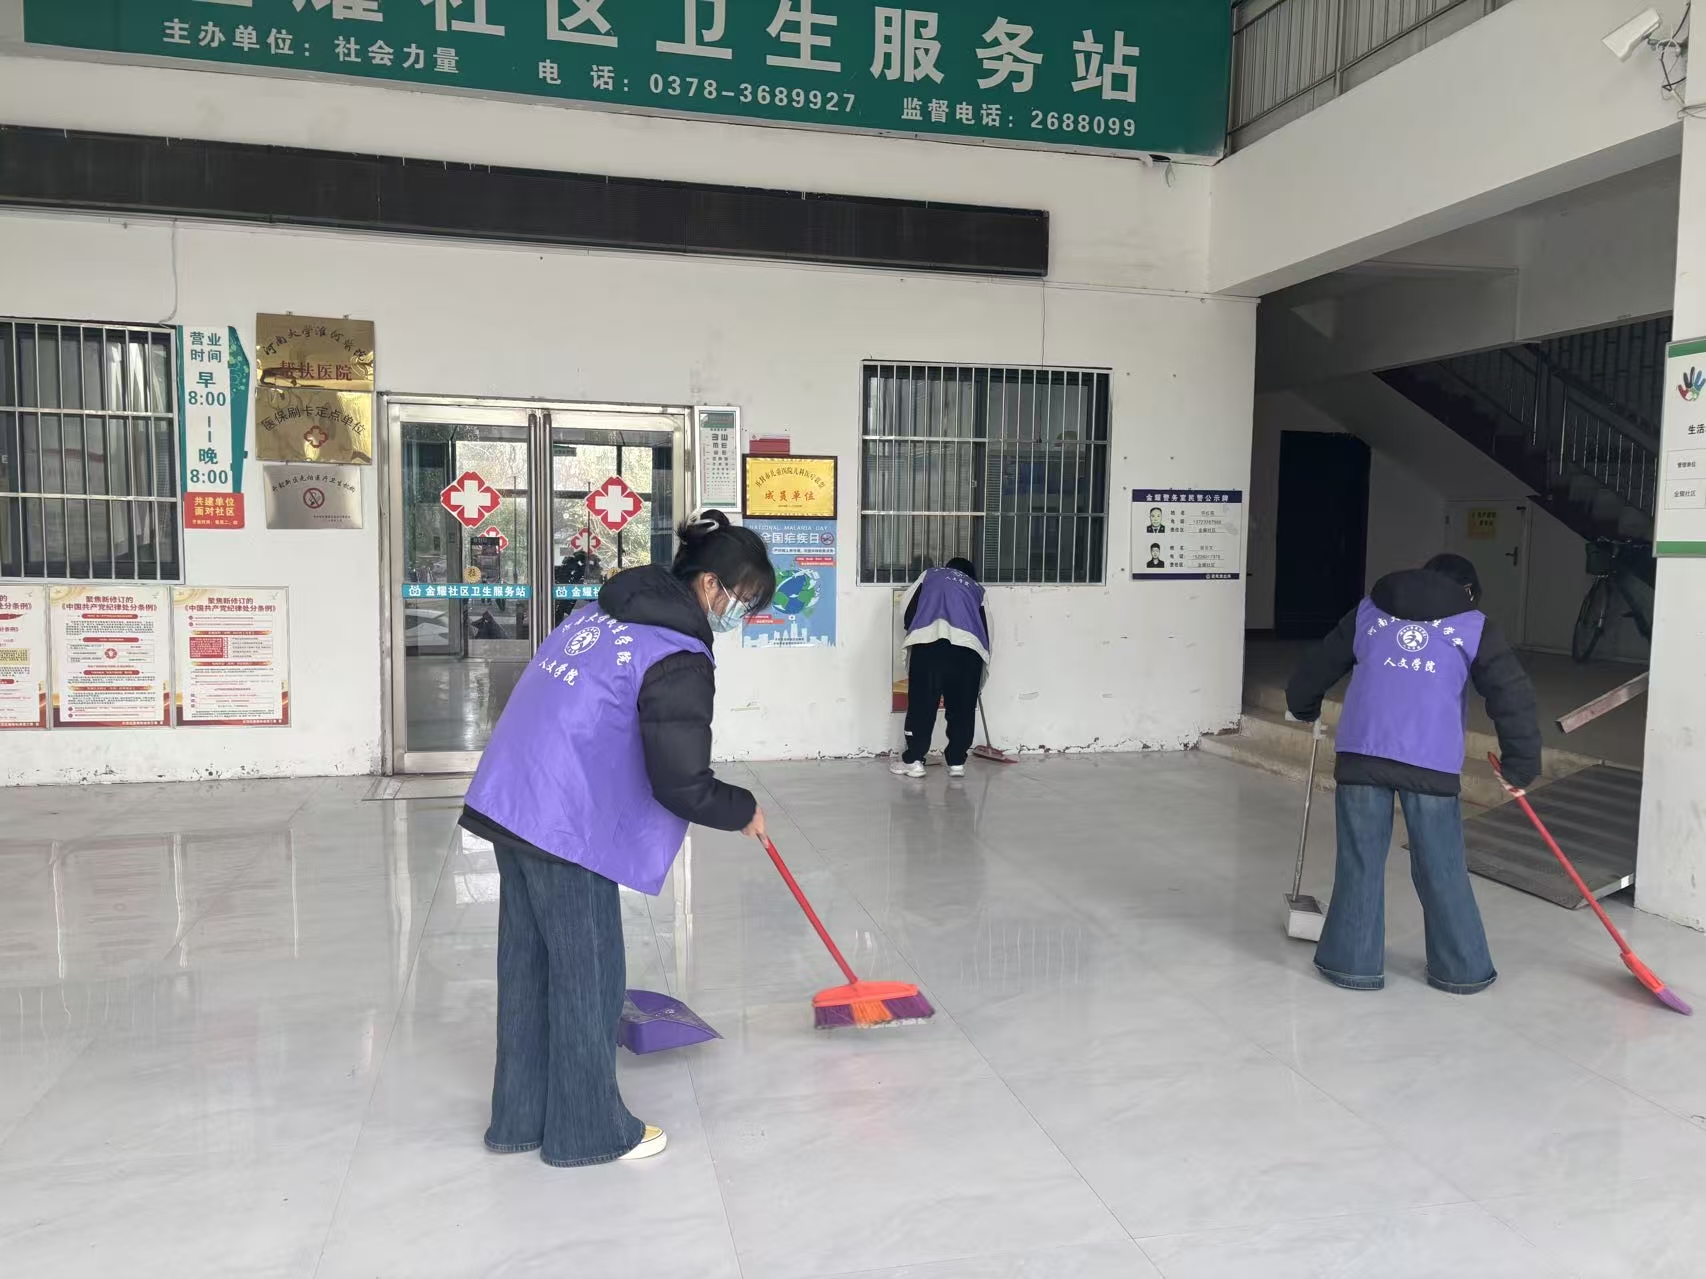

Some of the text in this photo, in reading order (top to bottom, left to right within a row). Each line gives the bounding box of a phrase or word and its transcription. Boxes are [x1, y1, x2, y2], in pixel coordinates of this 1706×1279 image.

[192, 0, 1140, 103] 区卫生服务站
[901, 97, 1137, 137] 监督电话：2688099
[190, 331, 222, 347] 营业
[190, 349, 222, 363] 时间
[280, 360, 353, 381] 帮扶医院
[196, 372, 216, 388] 早
[188, 391, 226, 406] 8:00
[261, 405, 365, 435] 医保刷卡定点单位
[198, 447, 218, 465] 晚
[190, 469, 228, 484] 8:00
[194, 496, 235, 506] 共建单位
[765, 490, 815, 502] 成员单位
[85, 595, 134, 603] 聚焦新修订的
[425, 585, 526, 598] 金耀社区卫生服务站
[62, 603, 158, 612] 《中国共产党纪律处分条例》
[208, 597, 253, 605] 聚焦新修订的
[185, 605, 276, 613] 《中国共产党纪律处分条例》
[538, 658, 579, 686] 人文学院
[1384, 657, 1436, 674] 人文学院
